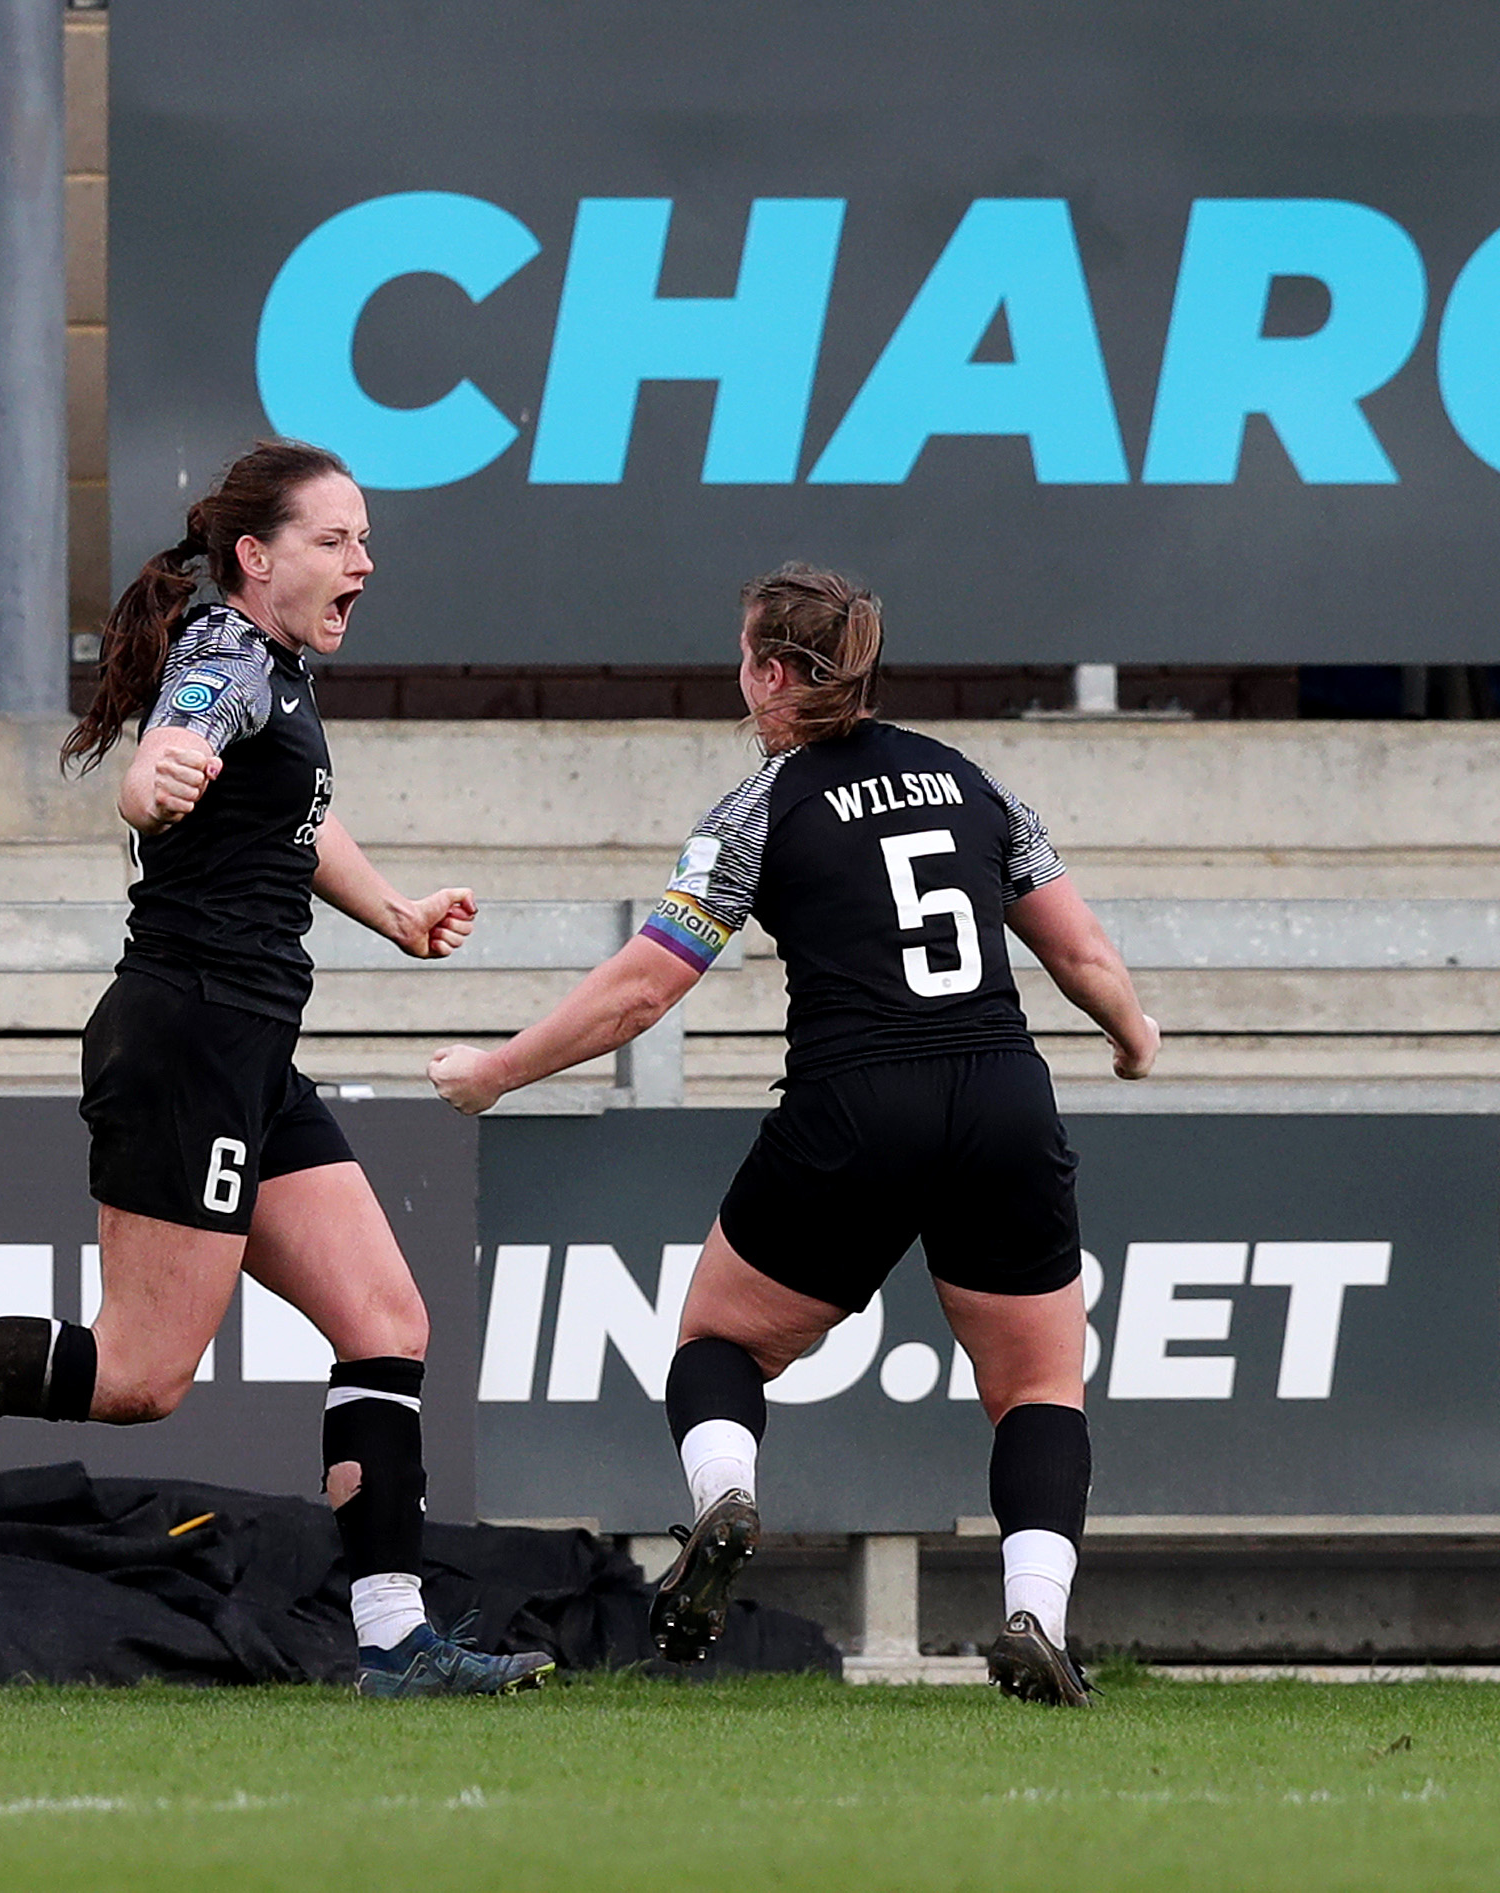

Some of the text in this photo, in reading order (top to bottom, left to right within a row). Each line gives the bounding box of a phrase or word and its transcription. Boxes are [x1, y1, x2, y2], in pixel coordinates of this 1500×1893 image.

[255, 190, 1500, 491] CHAR
[824, 773, 964, 823] WILSON
[880, 829, 982, 998] 5
[203, 1136, 247, 1214] 6
